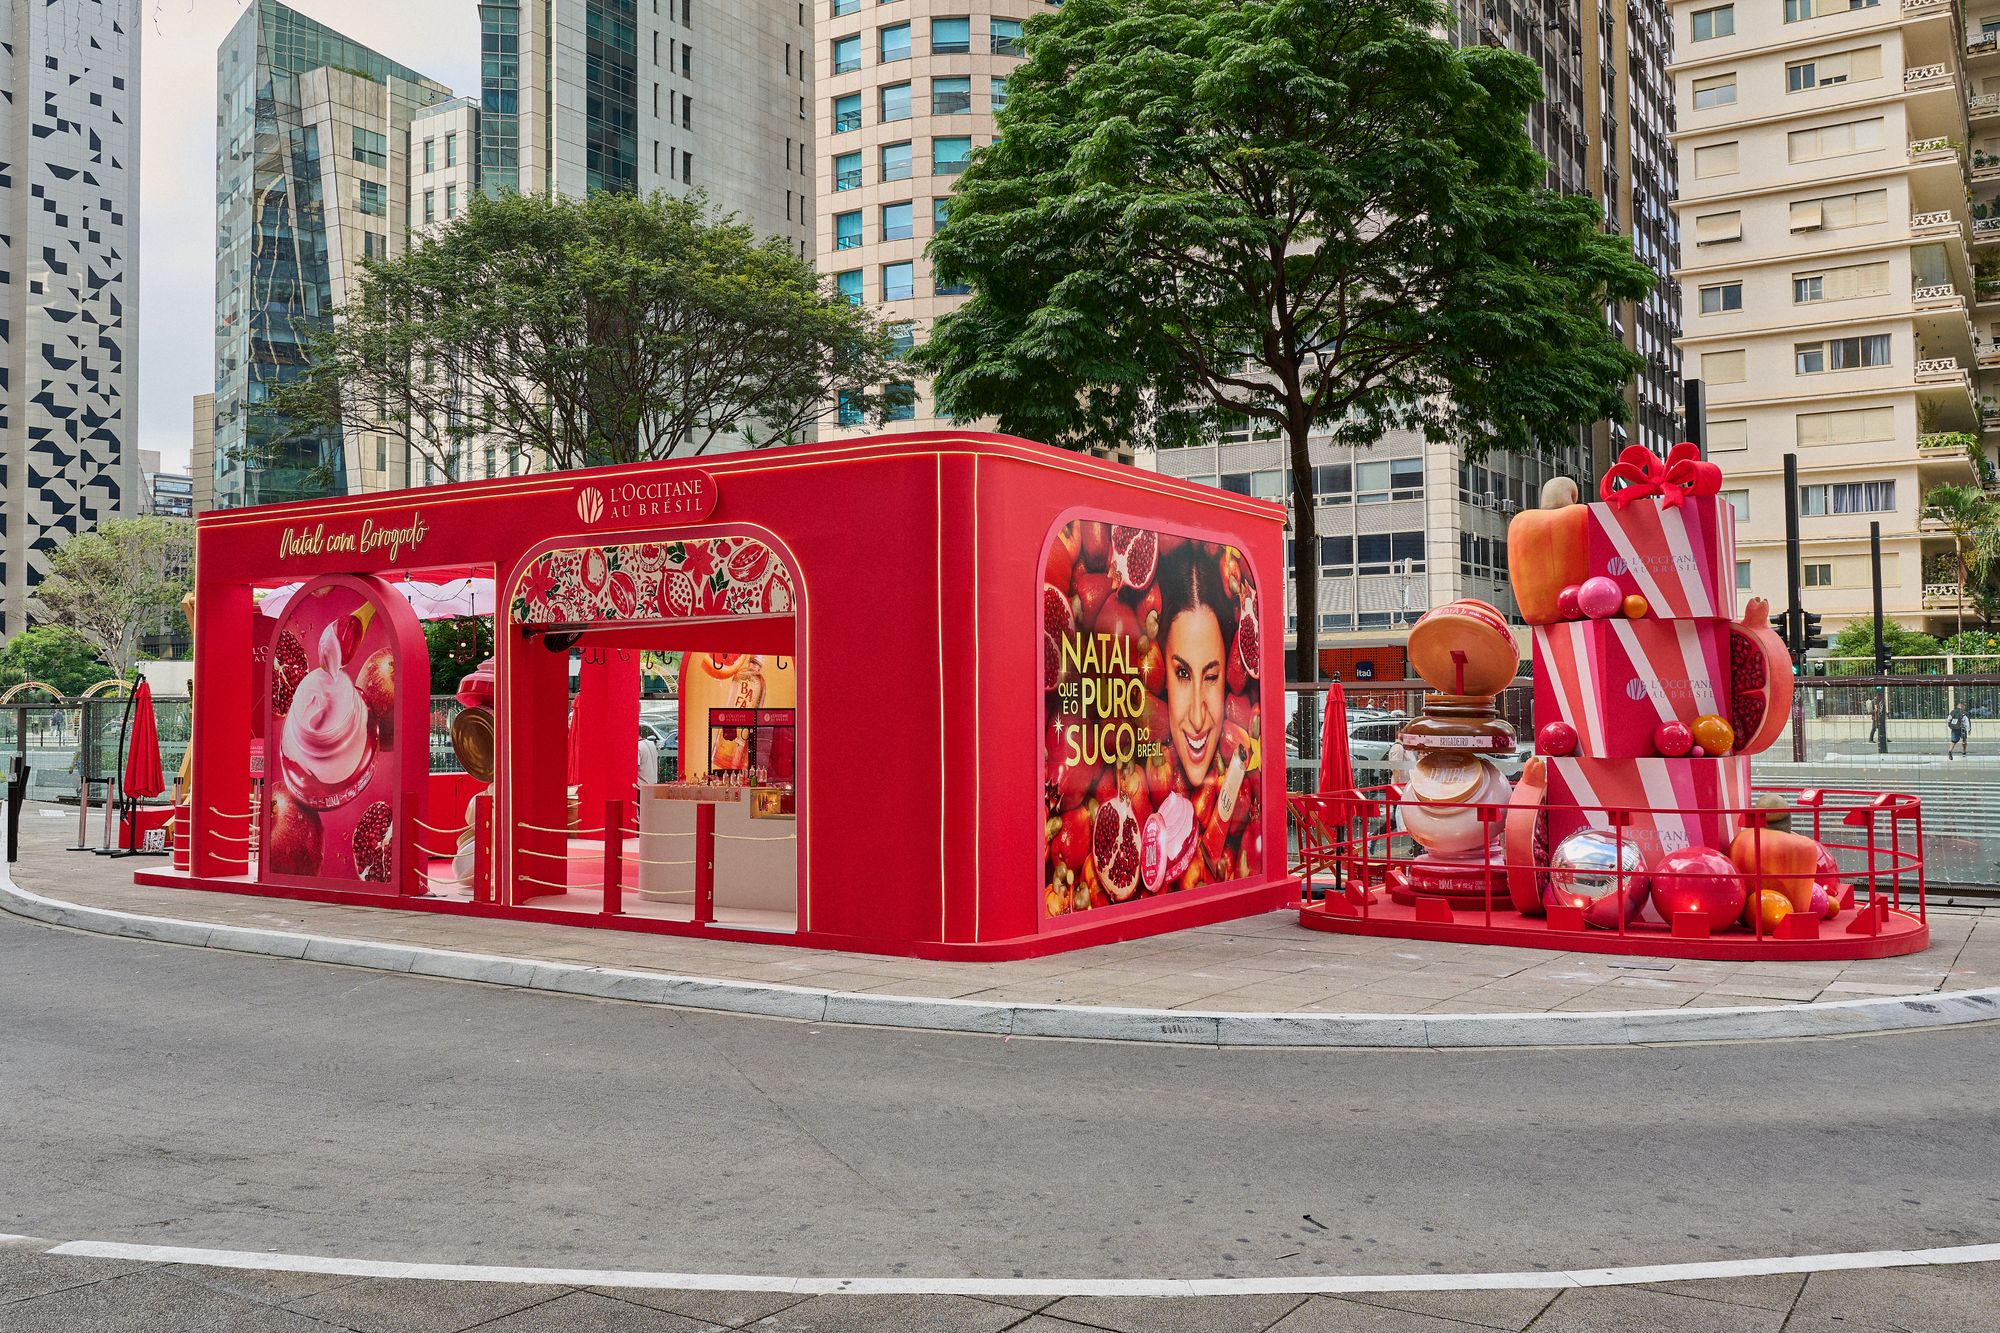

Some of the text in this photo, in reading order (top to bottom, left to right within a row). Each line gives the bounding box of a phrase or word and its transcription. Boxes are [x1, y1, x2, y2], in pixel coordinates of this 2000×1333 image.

[610, 479, 703, 503] L'OCCITANE
[611, 498, 703, 518] AU BRÉSIL
[280, 511, 429, 562] Natal com Borogodó
[1061, 630, 1139, 675] NATAL
[1356, 669, 1372, 677] itaú
[1058, 682, 1079, 698] QUE
[1081, 677, 1146, 719] PURO
[1063, 696, 1079, 715] É O
[1137, 727, 1150, 741] DO
[1065, 722, 1136, 767] SUCO
[1137, 740, 1163, 758] BRÉSIL
